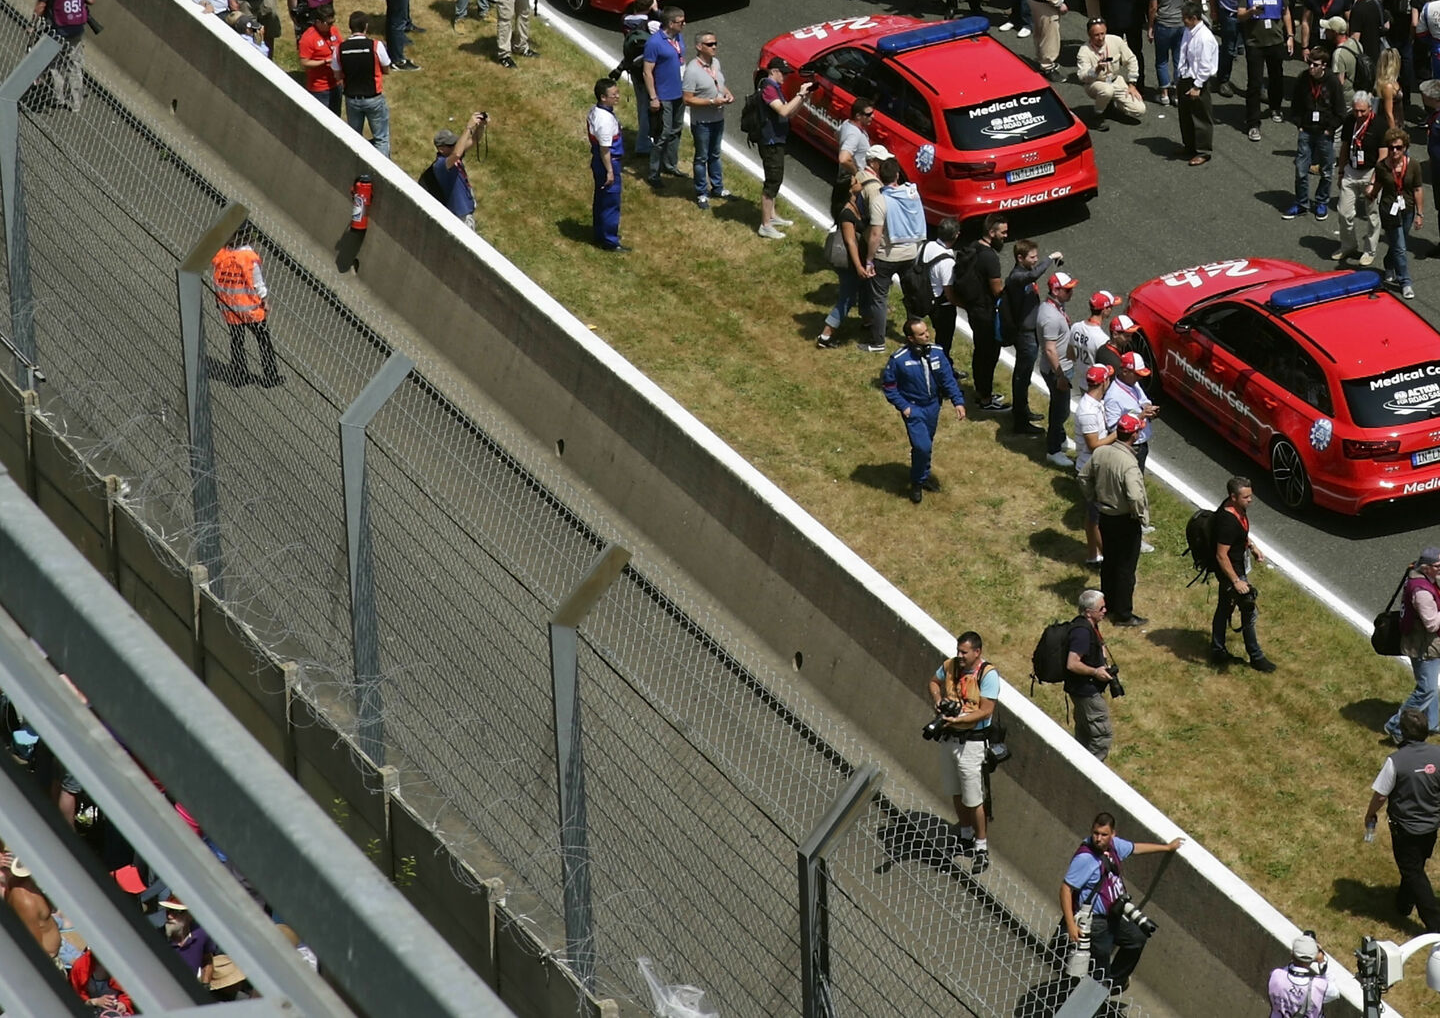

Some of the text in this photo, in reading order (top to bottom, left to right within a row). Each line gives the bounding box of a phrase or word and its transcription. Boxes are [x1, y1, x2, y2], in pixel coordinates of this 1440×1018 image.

[968, 94, 1042, 119] Medical Car
[1002, 111, 1032, 124] ACTION
[1020, 115, 1046, 127] SAFETY
[999, 185, 1072, 209] Medical Car
[1073, 331, 1089, 347] GBR
[1175, 351, 1252, 417] Medical Car
[1370, 368, 1425, 391] Medical
[1407, 383, 1440, 398] ACTION
[1408, 394, 1429, 405] ROAD
[1417, 451, 1429, 463] IN
